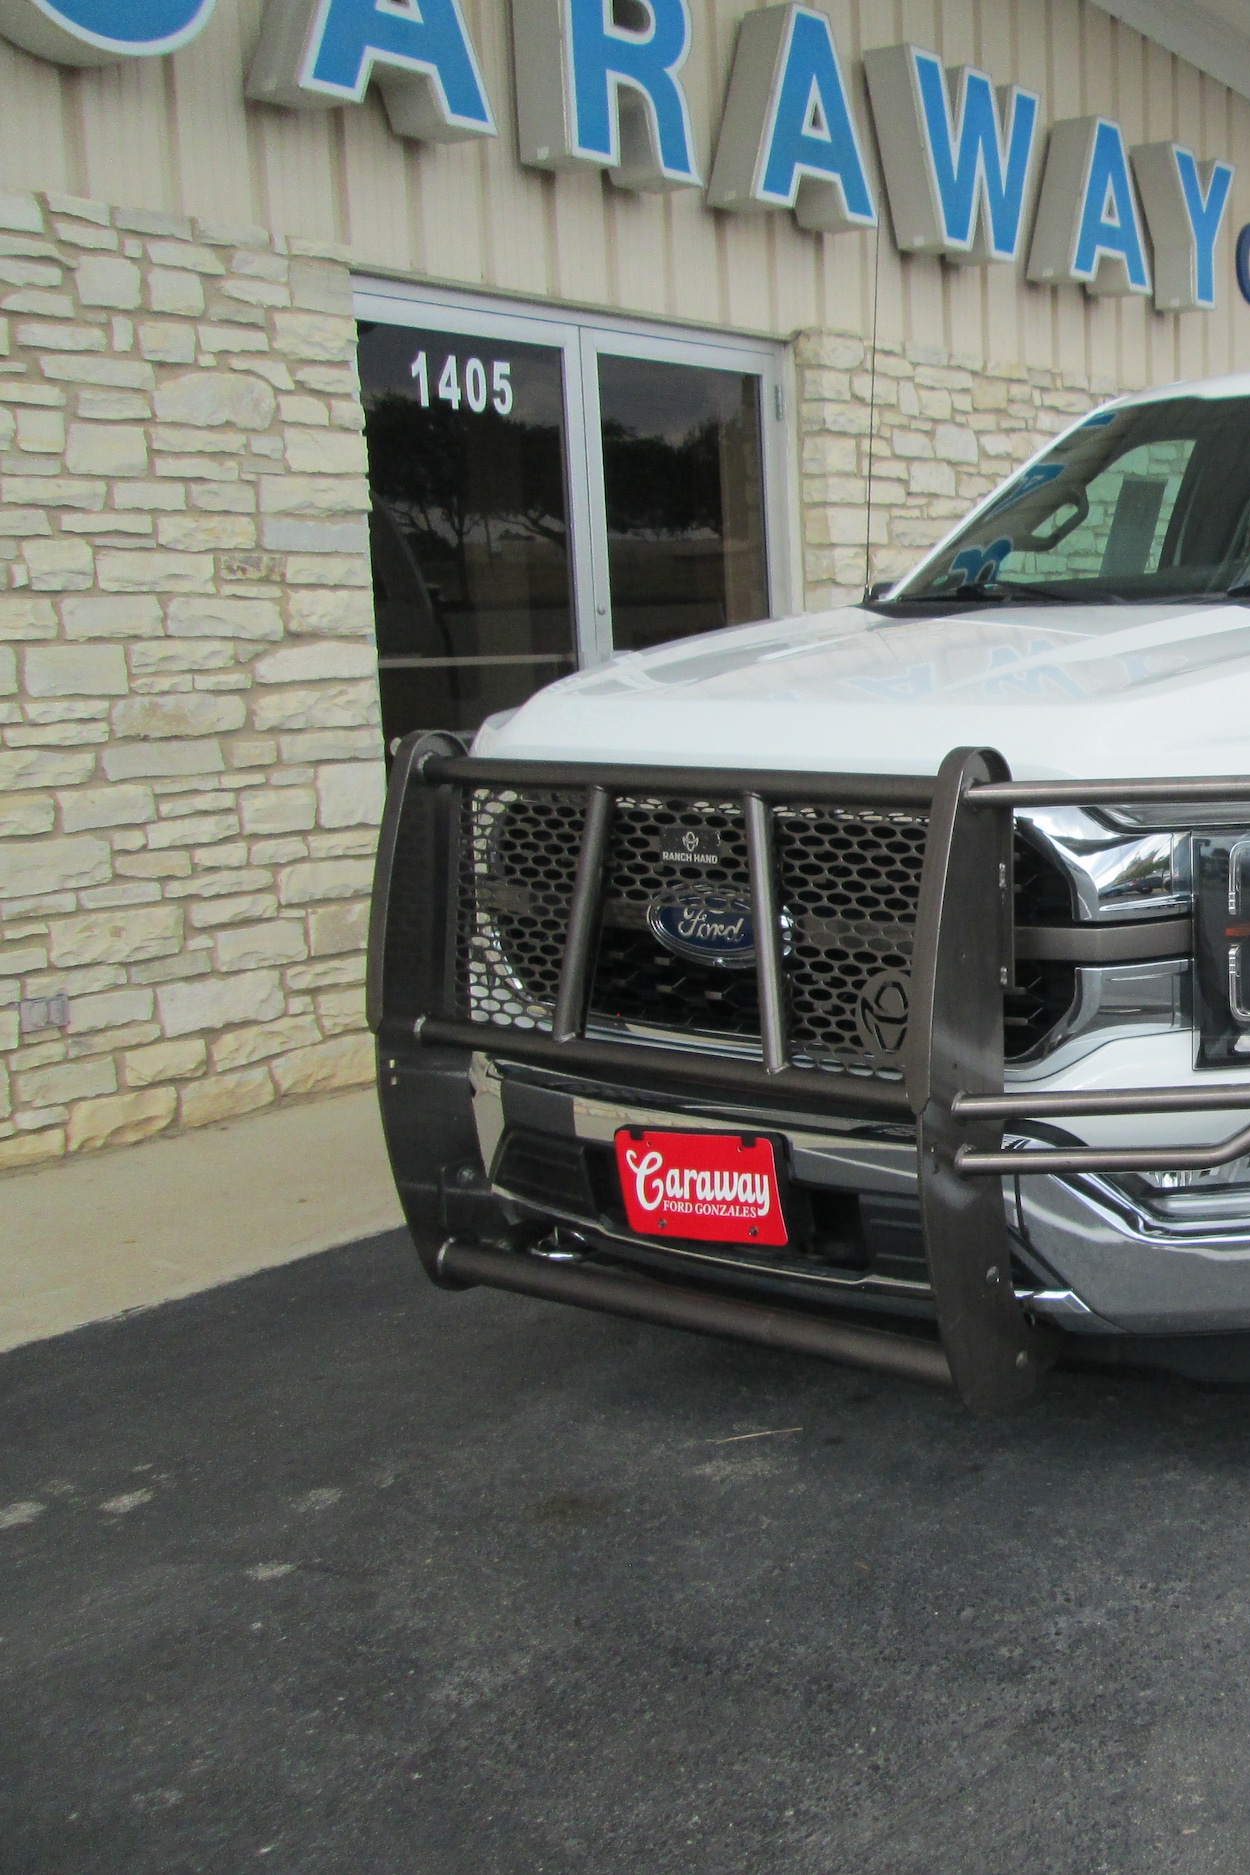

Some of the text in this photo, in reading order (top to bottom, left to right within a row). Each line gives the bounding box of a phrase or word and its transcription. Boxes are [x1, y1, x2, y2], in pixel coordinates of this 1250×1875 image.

[0, 0, 1236, 309] ARAWAY
[411, 350, 513, 415] 1405
[662, 851, 718, 864] RANCH HAND
[677, 905, 746, 943] Ford
[625, 1149, 770, 1217] Caraway
[663, 1200, 757, 1218] FORD GONZALES
